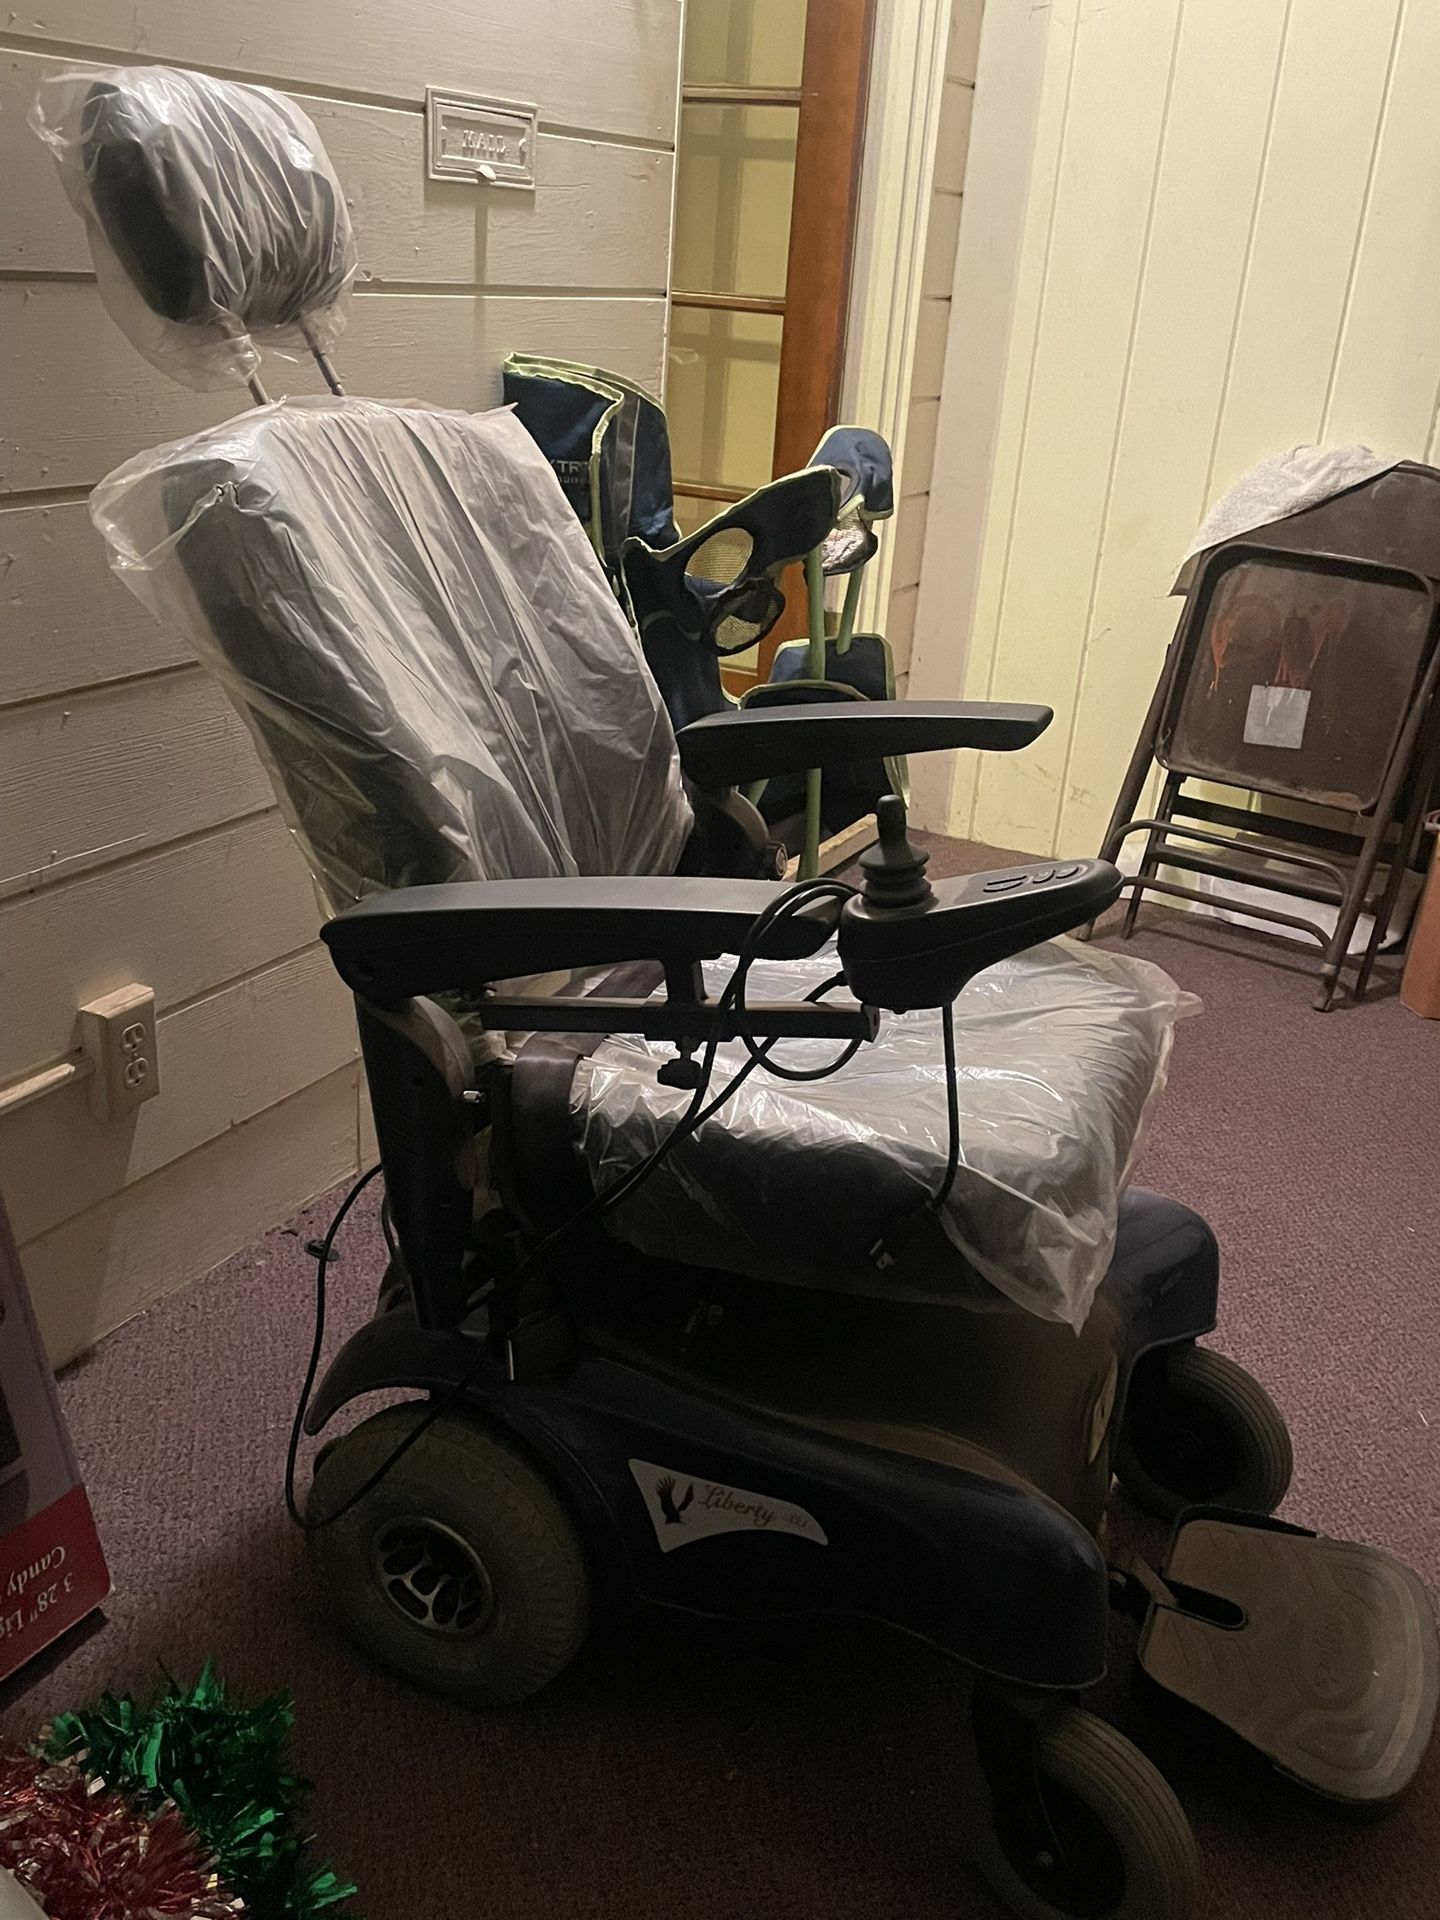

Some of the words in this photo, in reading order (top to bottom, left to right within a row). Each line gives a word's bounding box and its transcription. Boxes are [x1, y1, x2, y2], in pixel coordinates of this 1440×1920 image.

[698, 1484, 777, 1528] Liberty
[6, 1545, 66, 1597] Candy
[63, 1572, 73, 1593] 3
